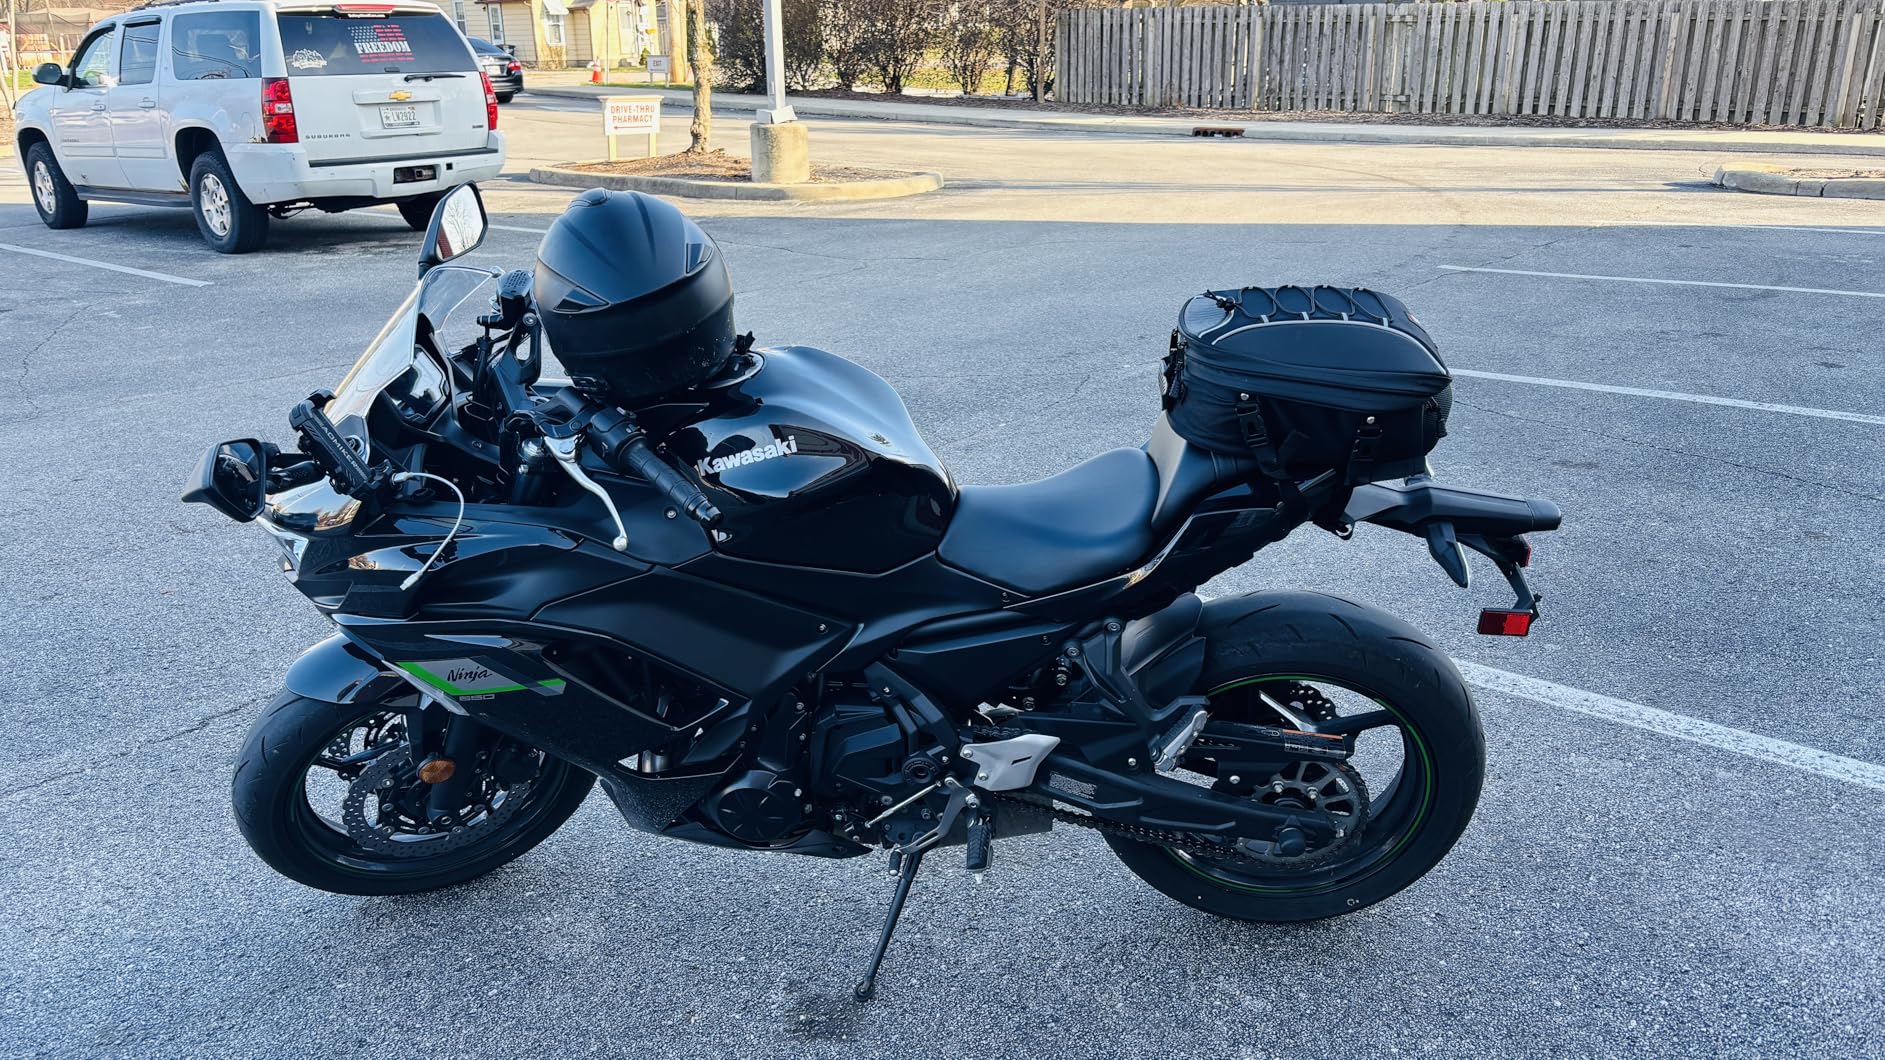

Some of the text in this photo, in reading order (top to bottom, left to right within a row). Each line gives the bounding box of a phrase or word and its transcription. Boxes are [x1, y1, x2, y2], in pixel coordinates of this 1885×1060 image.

[353, 41, 411, 54] FREEDOM
[610, 104, 655, 114] DRIVE-THRU
[612, 114, 653, 123] PHARMACY
[697, 435, 798, 477] Kawasaki
[447, 665, 493, 684] Ninja
